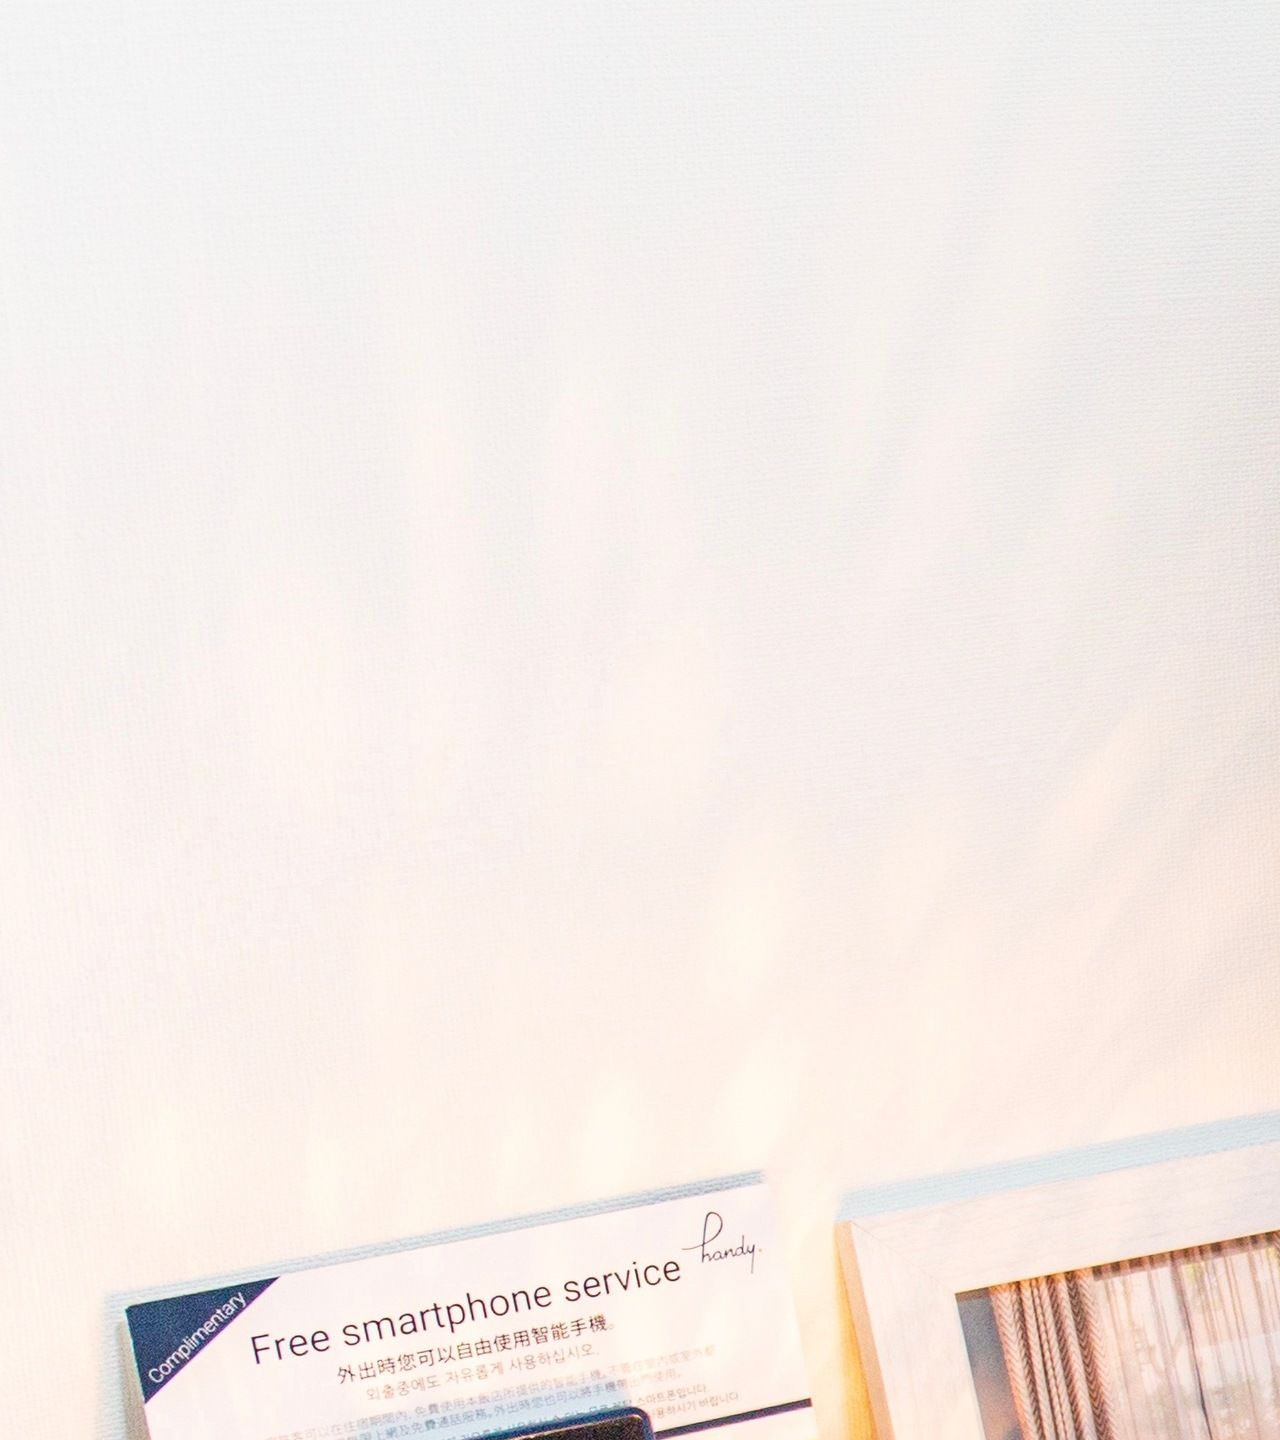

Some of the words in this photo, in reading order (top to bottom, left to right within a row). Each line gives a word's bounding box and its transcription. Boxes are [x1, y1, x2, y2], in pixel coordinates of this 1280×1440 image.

[148, 1291, 247, 1384] Complimentary
[251, 1330, 330, 1365] Free
[341, 1286, 552, 1346] smartphone
[563, 1260, 681, 1302] service
